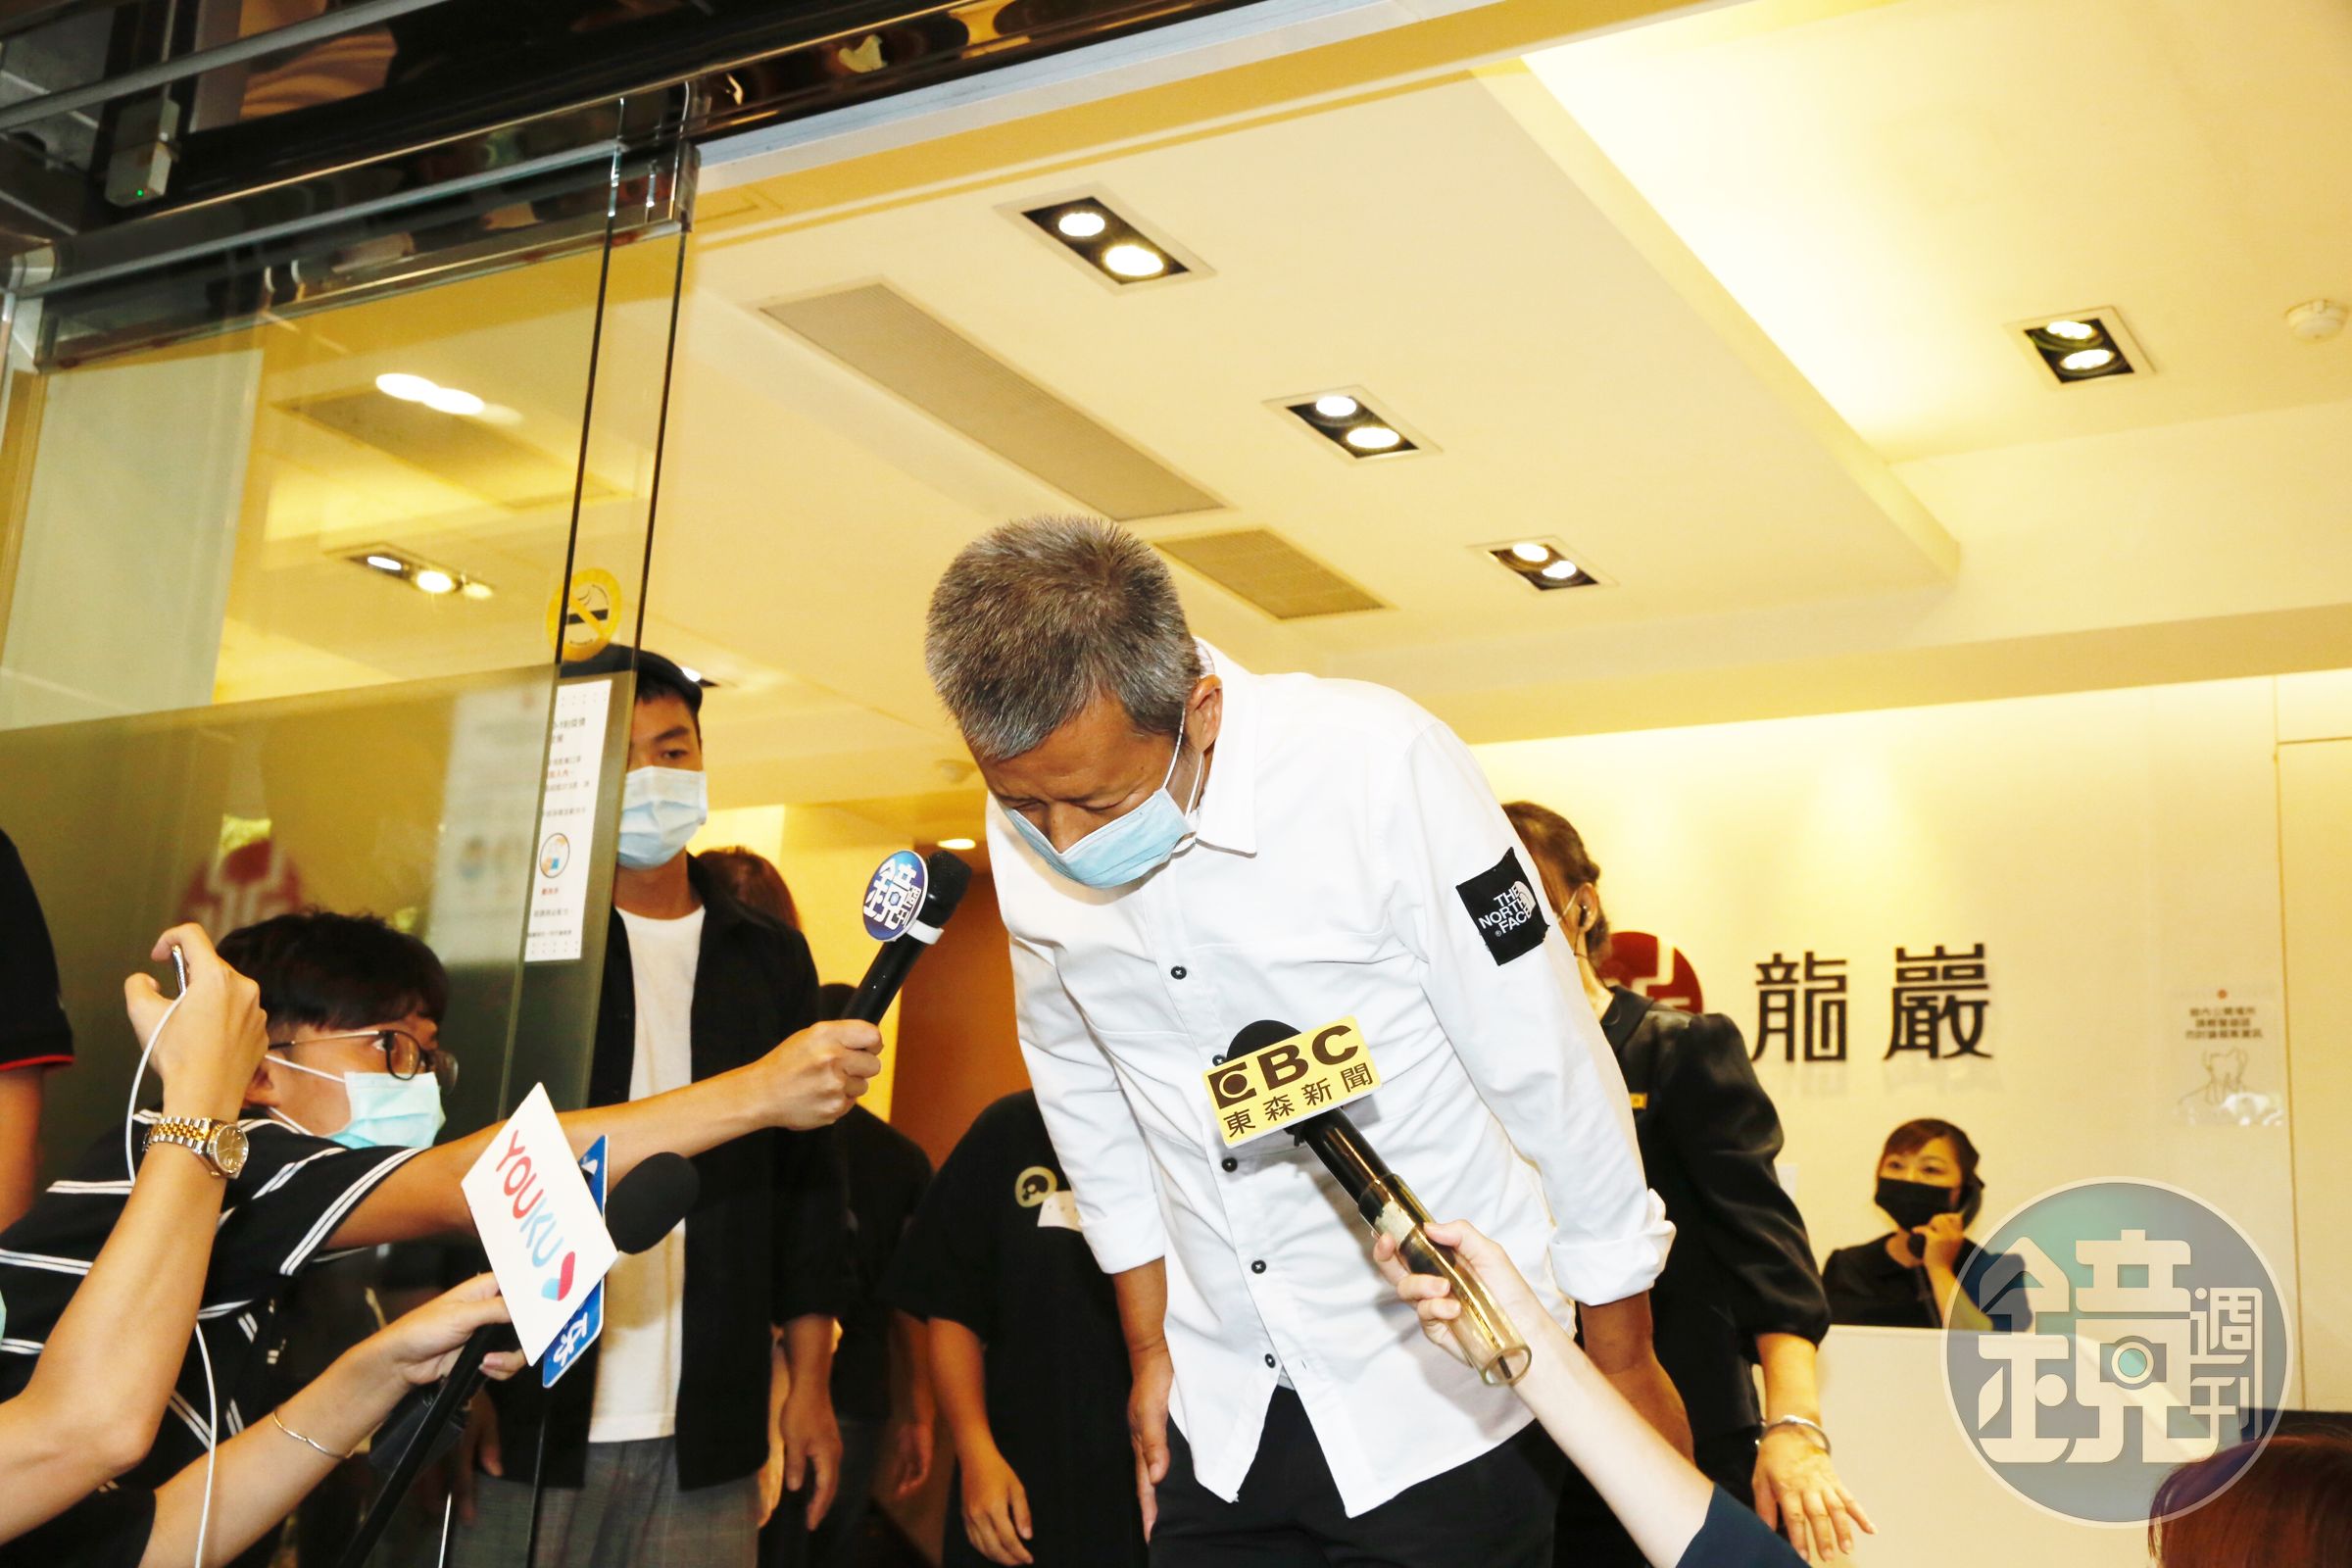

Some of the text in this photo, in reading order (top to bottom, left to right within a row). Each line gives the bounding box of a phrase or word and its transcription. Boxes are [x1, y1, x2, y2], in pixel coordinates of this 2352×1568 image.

[1493, 885, 1520, 907] THE
[1497, 906, 1532, 934] FACE
[1751, 943, 1993, 1062] 龍巖
[1207, 1025, 1359, 1109] EBC
[1223, 1062, 1374, 1138] 東森新聞
[496, 1129, 564, 1268] YOUKU
[552, 1304, 589, 1367] 乐
